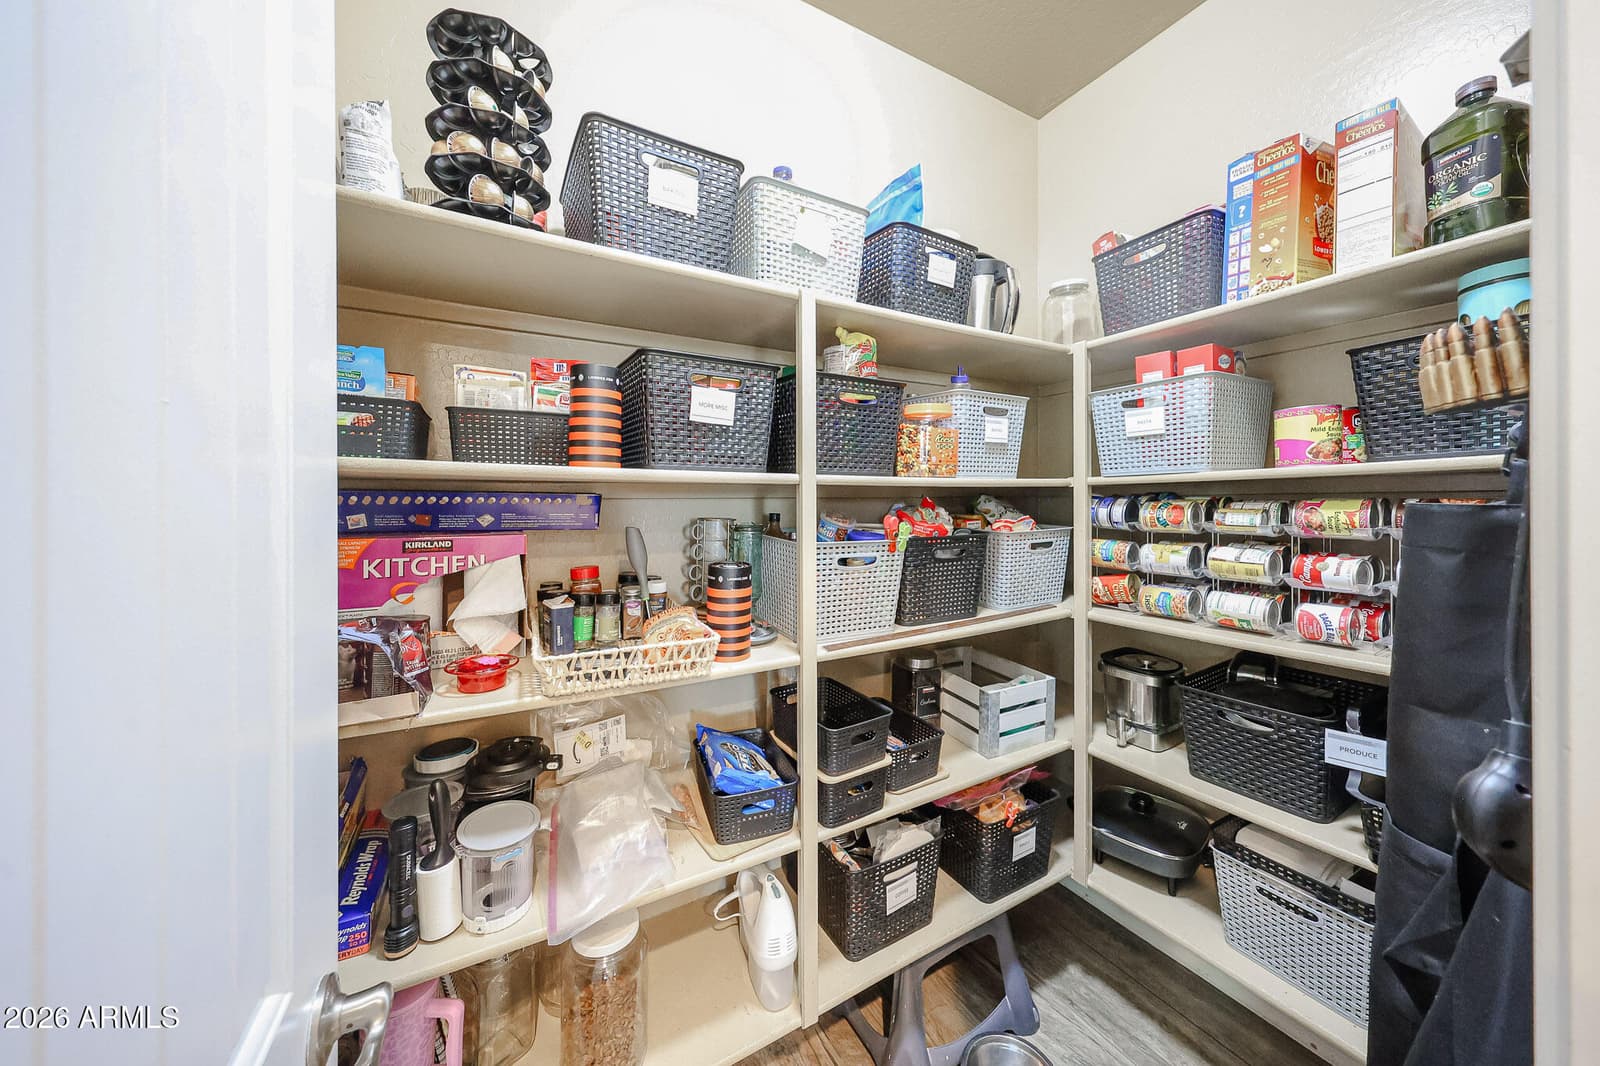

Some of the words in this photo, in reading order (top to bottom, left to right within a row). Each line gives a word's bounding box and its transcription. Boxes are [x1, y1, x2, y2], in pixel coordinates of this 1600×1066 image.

[1346, 121, 1386, 142] Cheerios
[1257, 144, 1296, 167] Cheerios
[1428, 152, 1488, 184] ORGANIC
[698, 400, 714, 409] MORE
[405, 541, 452, 549] KIRKLAND
[362, 554, 487, 579] KITCHEN
[1339, 745, 1379, 760] PRODUCE
[340, 862, 371, 906] Reynolds
[356, 840, 383, 863] Wrap
[348, 932, 368, 942] 250
